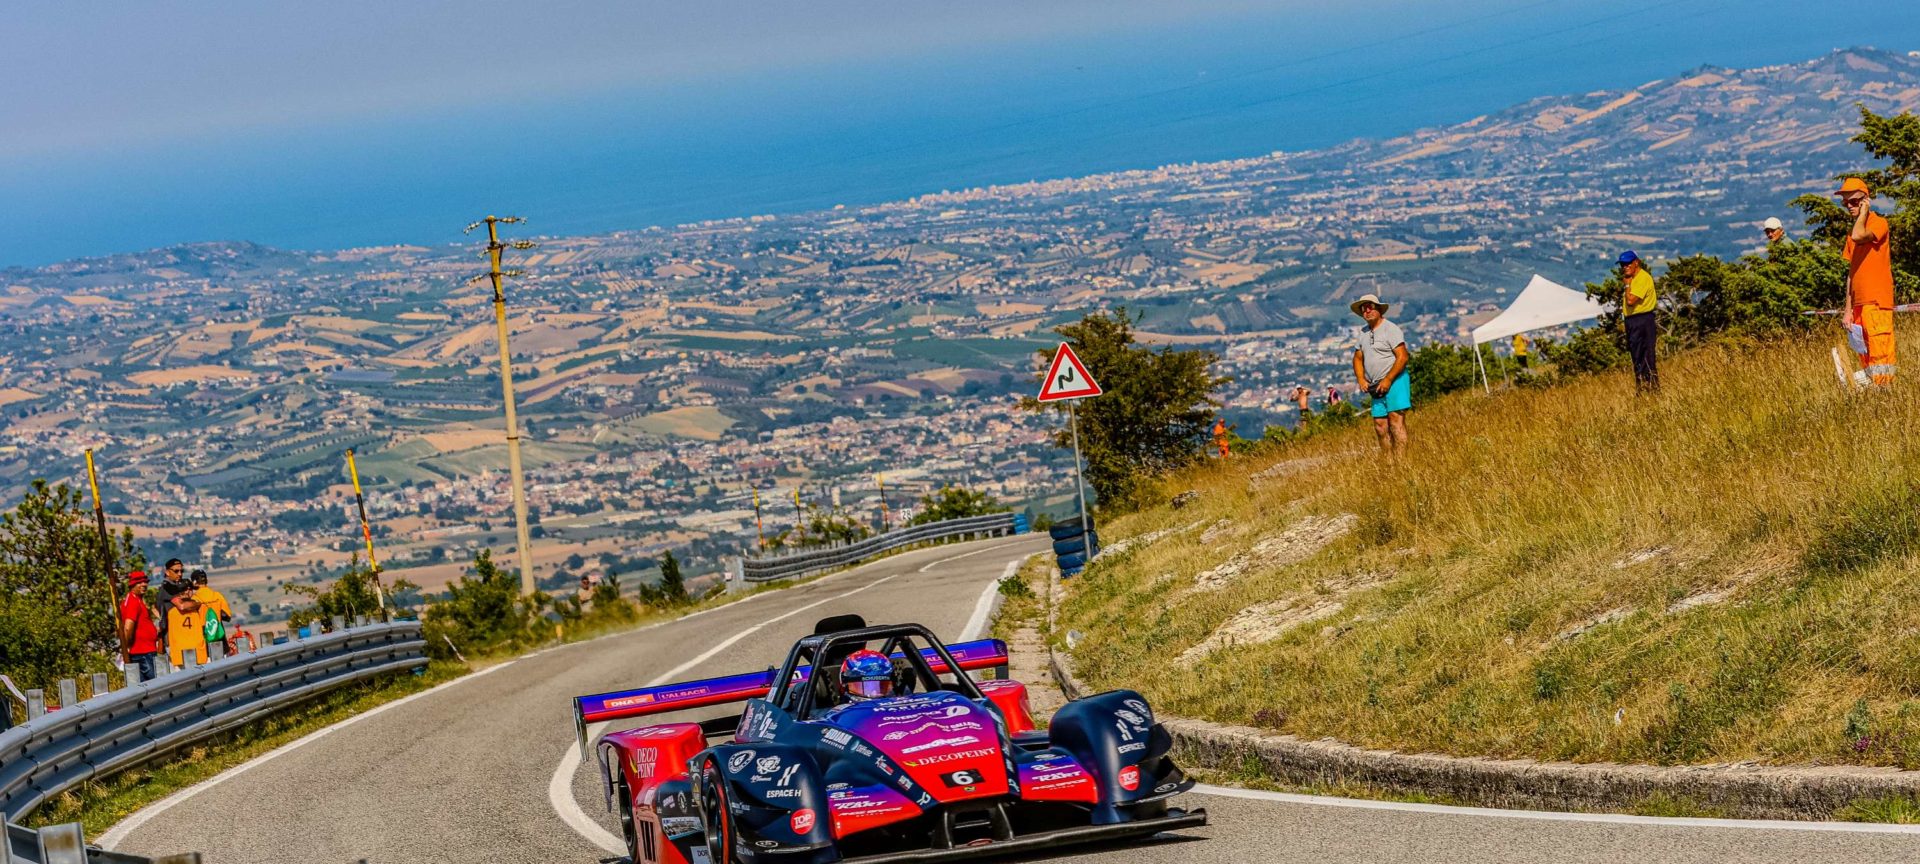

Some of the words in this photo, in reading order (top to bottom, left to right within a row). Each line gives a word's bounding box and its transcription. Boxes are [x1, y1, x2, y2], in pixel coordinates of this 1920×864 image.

[182, 616, 193, 630] 4
[661, 688, 707, 700] L'ALSACE
[611, 699, 634, 708] DNA
[637, 747, 658, 763] DECO
[918, 747, 996, 766] DECOPEINT
[637, 763, 656, 779] PEINT
[952, 770, 974, 785] 6
[1121, 770, 1138, 781] TOP
[766, 789, 794, 799] ESPACE
[794, 789, 802, 798] H
[794, 813, 812, 825] TOP
